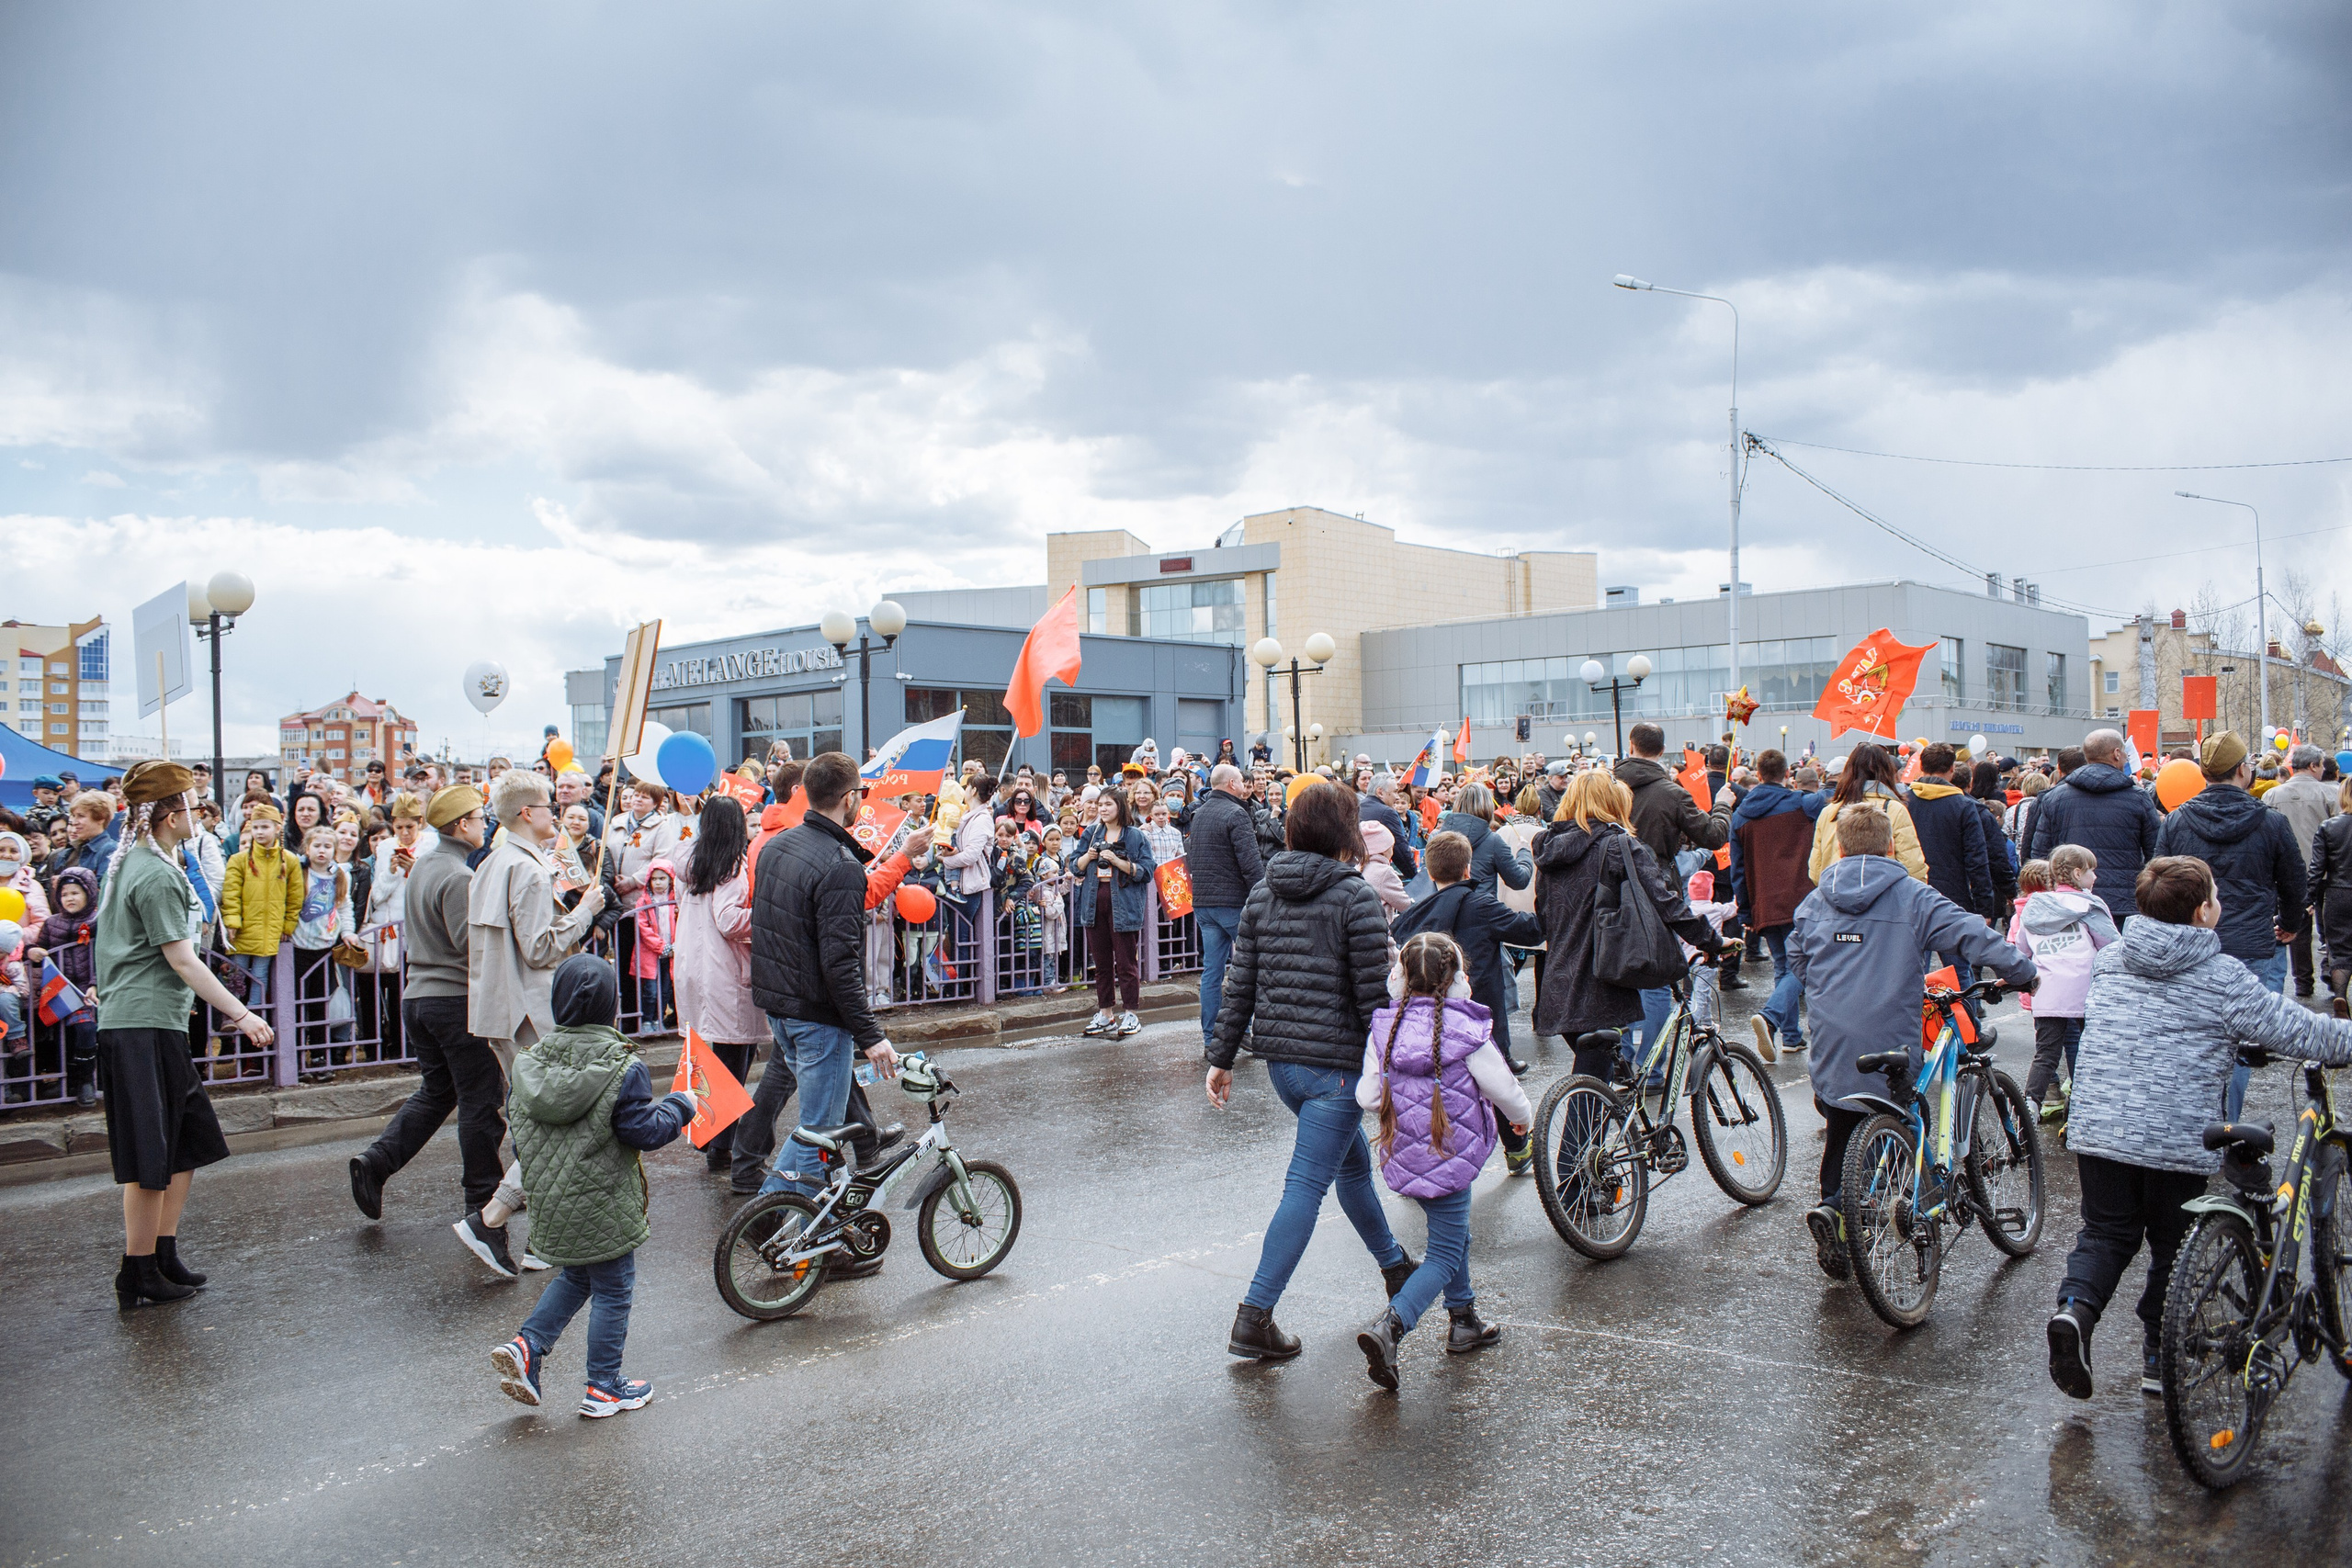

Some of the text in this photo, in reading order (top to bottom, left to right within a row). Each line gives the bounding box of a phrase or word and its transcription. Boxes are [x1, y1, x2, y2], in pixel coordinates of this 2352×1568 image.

[668, 649, 775, 688] MELANGE
[779, 647, 842, 674] HOUSE
[1837, 934, 1861, 942] LEVEL
[1669, 1037, 1687, 1110] NOVATRACK
[2291, 1134, 2306, 1164] ATTACK
[2292, 1165, 2312, 1243] STERN
